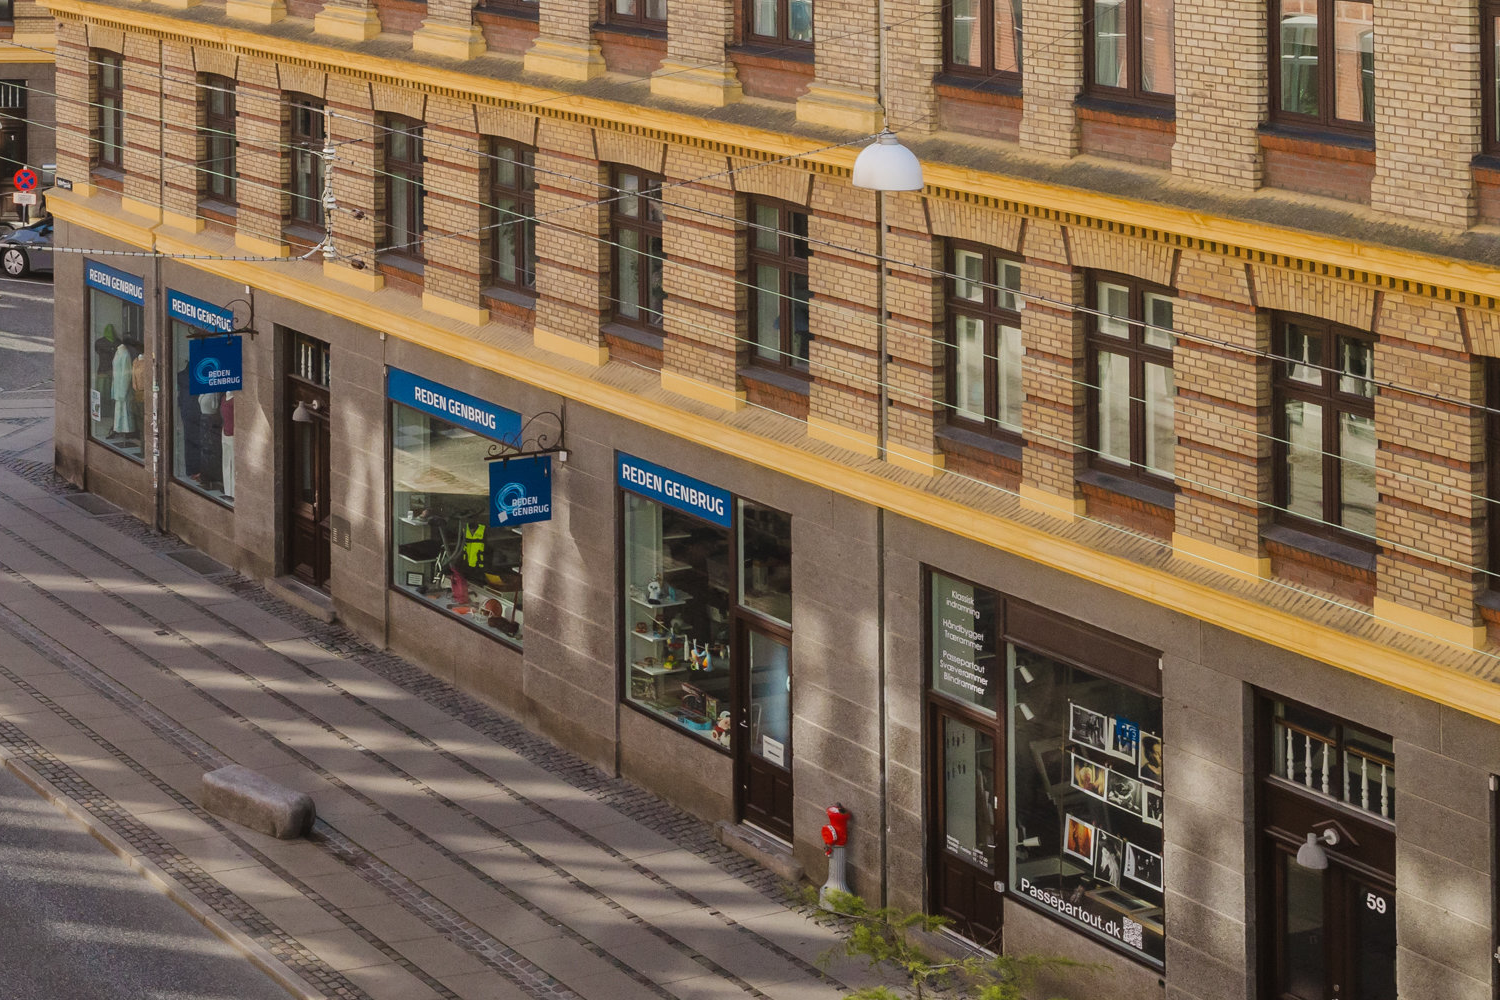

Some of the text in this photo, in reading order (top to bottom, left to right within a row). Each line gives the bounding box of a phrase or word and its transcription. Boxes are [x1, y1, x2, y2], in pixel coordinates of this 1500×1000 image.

[89, 268, 143, 300] REDEN GENBRUG
[172, 298, 232, 332] REDEN GENBRUG
[208, 369, 230, 378] REDEN
[208, 376, 240, 386] GENBRUG
[414, 386, 496, 430] REDEN GENBRUG
[512, 496, 538, 507] REDEN
[622, 464, 724, 516] REDEN GENBRUG
[512, 504, 549, 517] GENBRUG
[946, 597, 980, 619] indramning
[951, 590, 974, 604] Klassisk
[942, 618, 984, 641] Håndbygget
[944, 630, 983, 651] Trærammer
[940, 660, 988, 686] Svæverammer
[942, 650, 985, 673] Passepartout
[944, 672, 984, 695] Blindrammer
[1021, 878, 1121, 938] Passepartout.dk
[1366, 892, 1386, 914] 59
